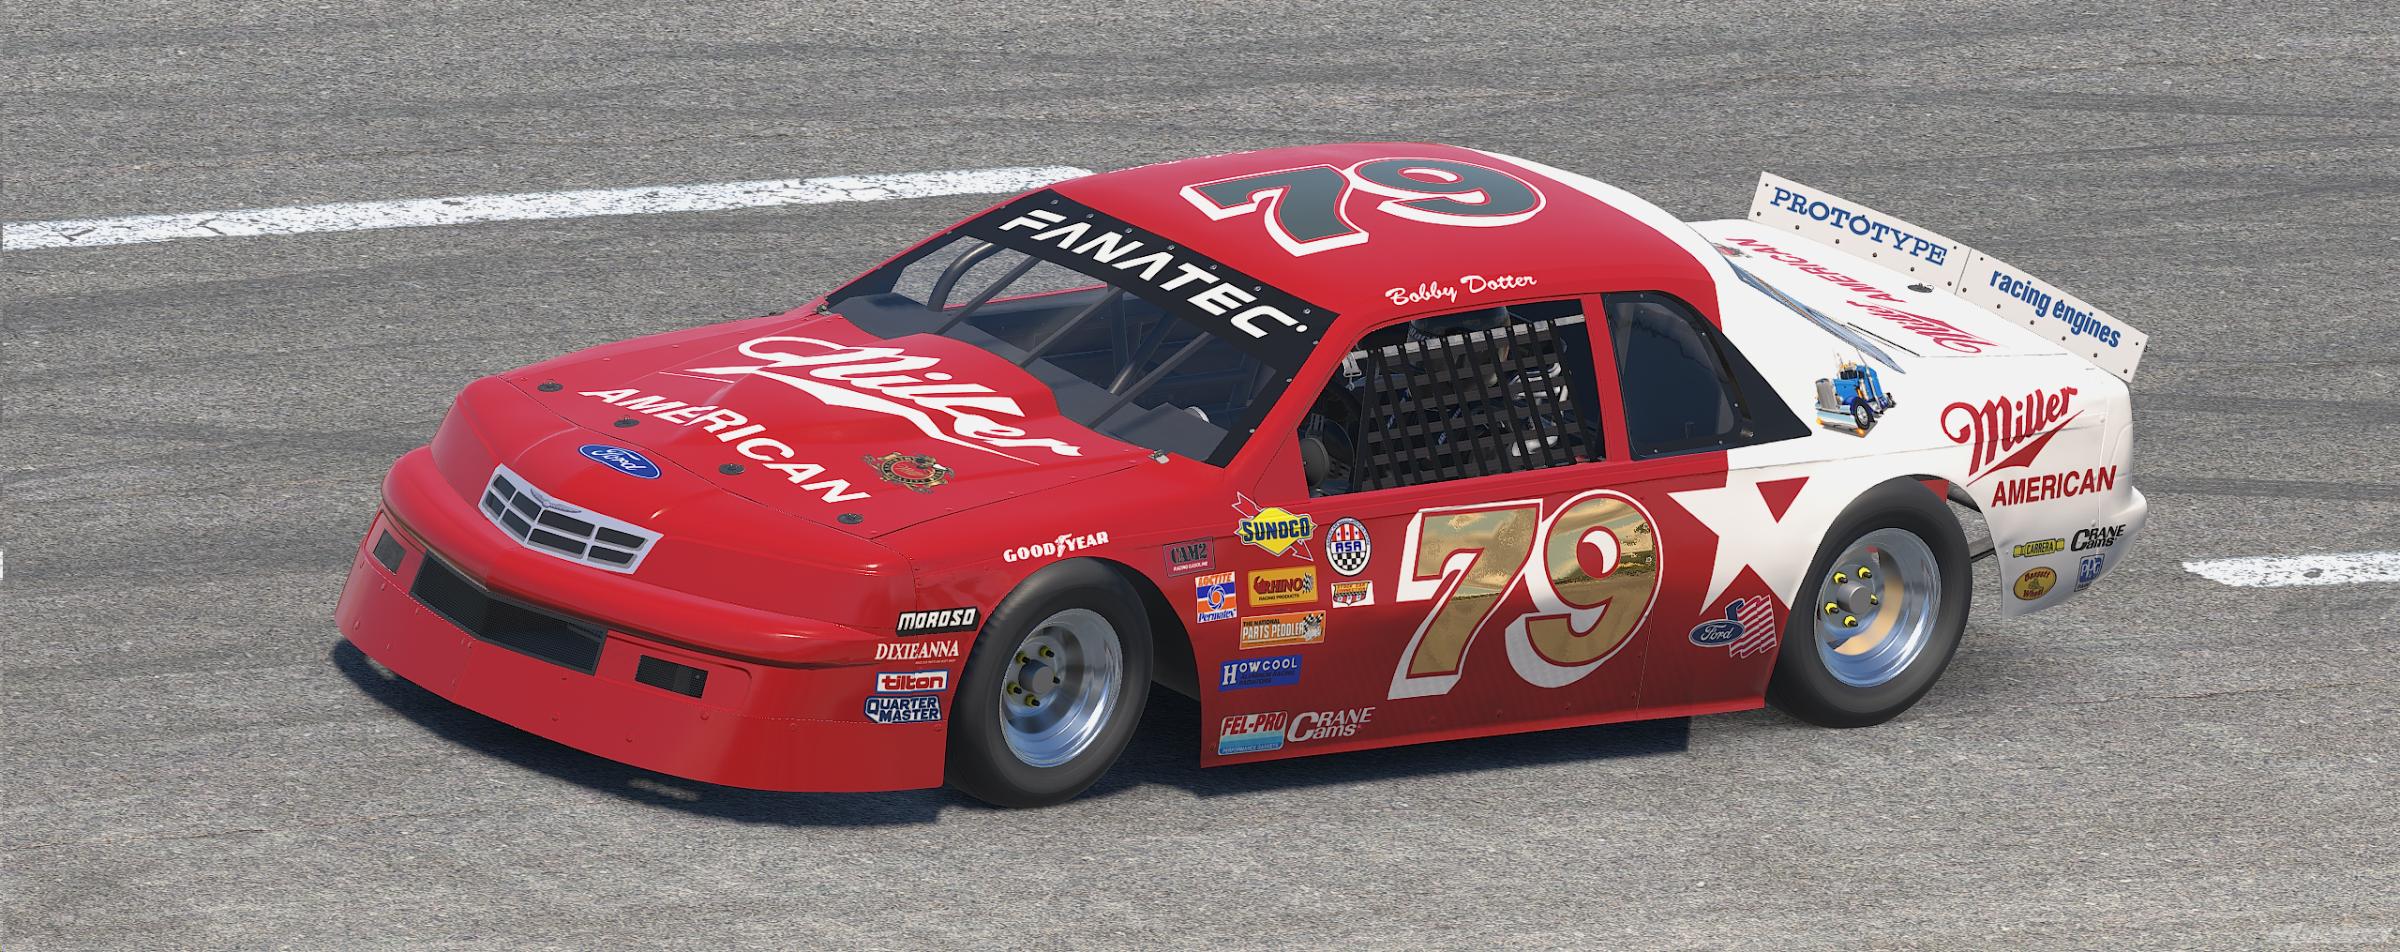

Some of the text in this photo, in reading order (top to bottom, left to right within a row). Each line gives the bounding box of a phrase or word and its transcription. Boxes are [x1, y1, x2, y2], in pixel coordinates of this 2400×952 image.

[1180, 157, 1547, 258] 79
[1770, 186, 1948, 266] PROTOTYPE
[998, 209, 1299, 340] FANATEC
[1385, 274, 1537, 306] Bobby Dotter
[1989, 267, 2122, 349] racing engines
[735, 336, 1084, 457] Miller
[1941, 386, 2078, 477] Miller
[578, 387, 872, 504] AMERICAN
[1990, 465, 2117, 508] AMERICAN
[1241, 517, 1310, 542] SUNOCO
[1170, 543, 1208, 565] CAM2
[1335, 541, 1362, 553] ASA
[2026, 541, 2054, 555] CARRERA
[1198, 572, 1233, 586] LOCTITE
[1387, 488, 1664, 700] 79
[897, 608, 977, 631] MOROSO
[1242, 625, 1270, 641] PARTS
[1271, 622, 1304, 638] PEDDLER
[1698, 624, 1735, 641] Ford
[874, 640, 960, 660] DIXIEANNA
[882, 675, 944, 691] tilton
[866, 696, 938, 715] QUARTER
[880, 709, 939, 722] MASTER
[1221, 712, 1286, 736] FEL-PRO
